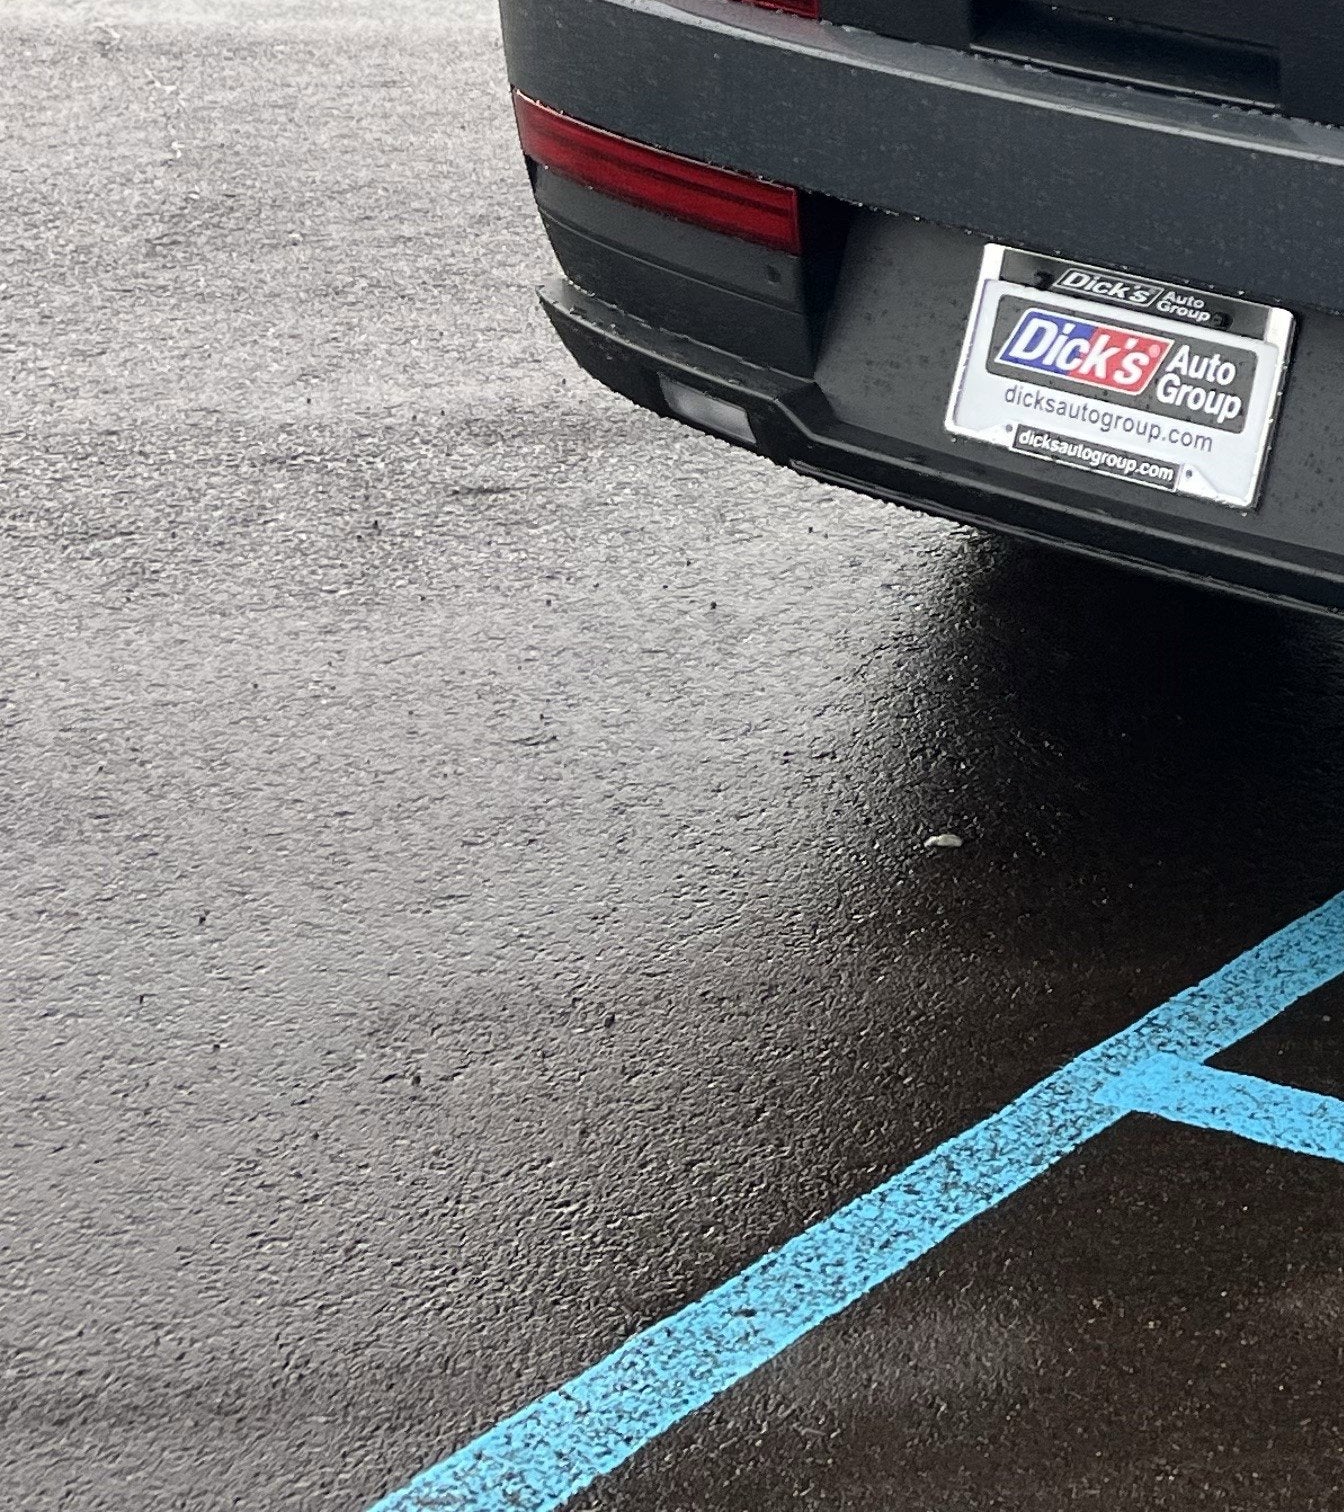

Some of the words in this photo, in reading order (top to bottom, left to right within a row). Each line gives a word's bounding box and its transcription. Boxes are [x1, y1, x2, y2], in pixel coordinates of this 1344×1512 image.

[1062, 271, 1150, 304] Dick's
[1161, 291, 1206, 309] Auto
[1156, 301, 1212, 323] Group
[1009, 317, 1152, 386] Dick's
[1165, 345, 1237, 386] Auto
[1004, 385, 1213, 453] dicksautogroup.com
[1156, 374, 1242, 424] Group
[1018, 430, 1175, 482] dicksautogroup.com
